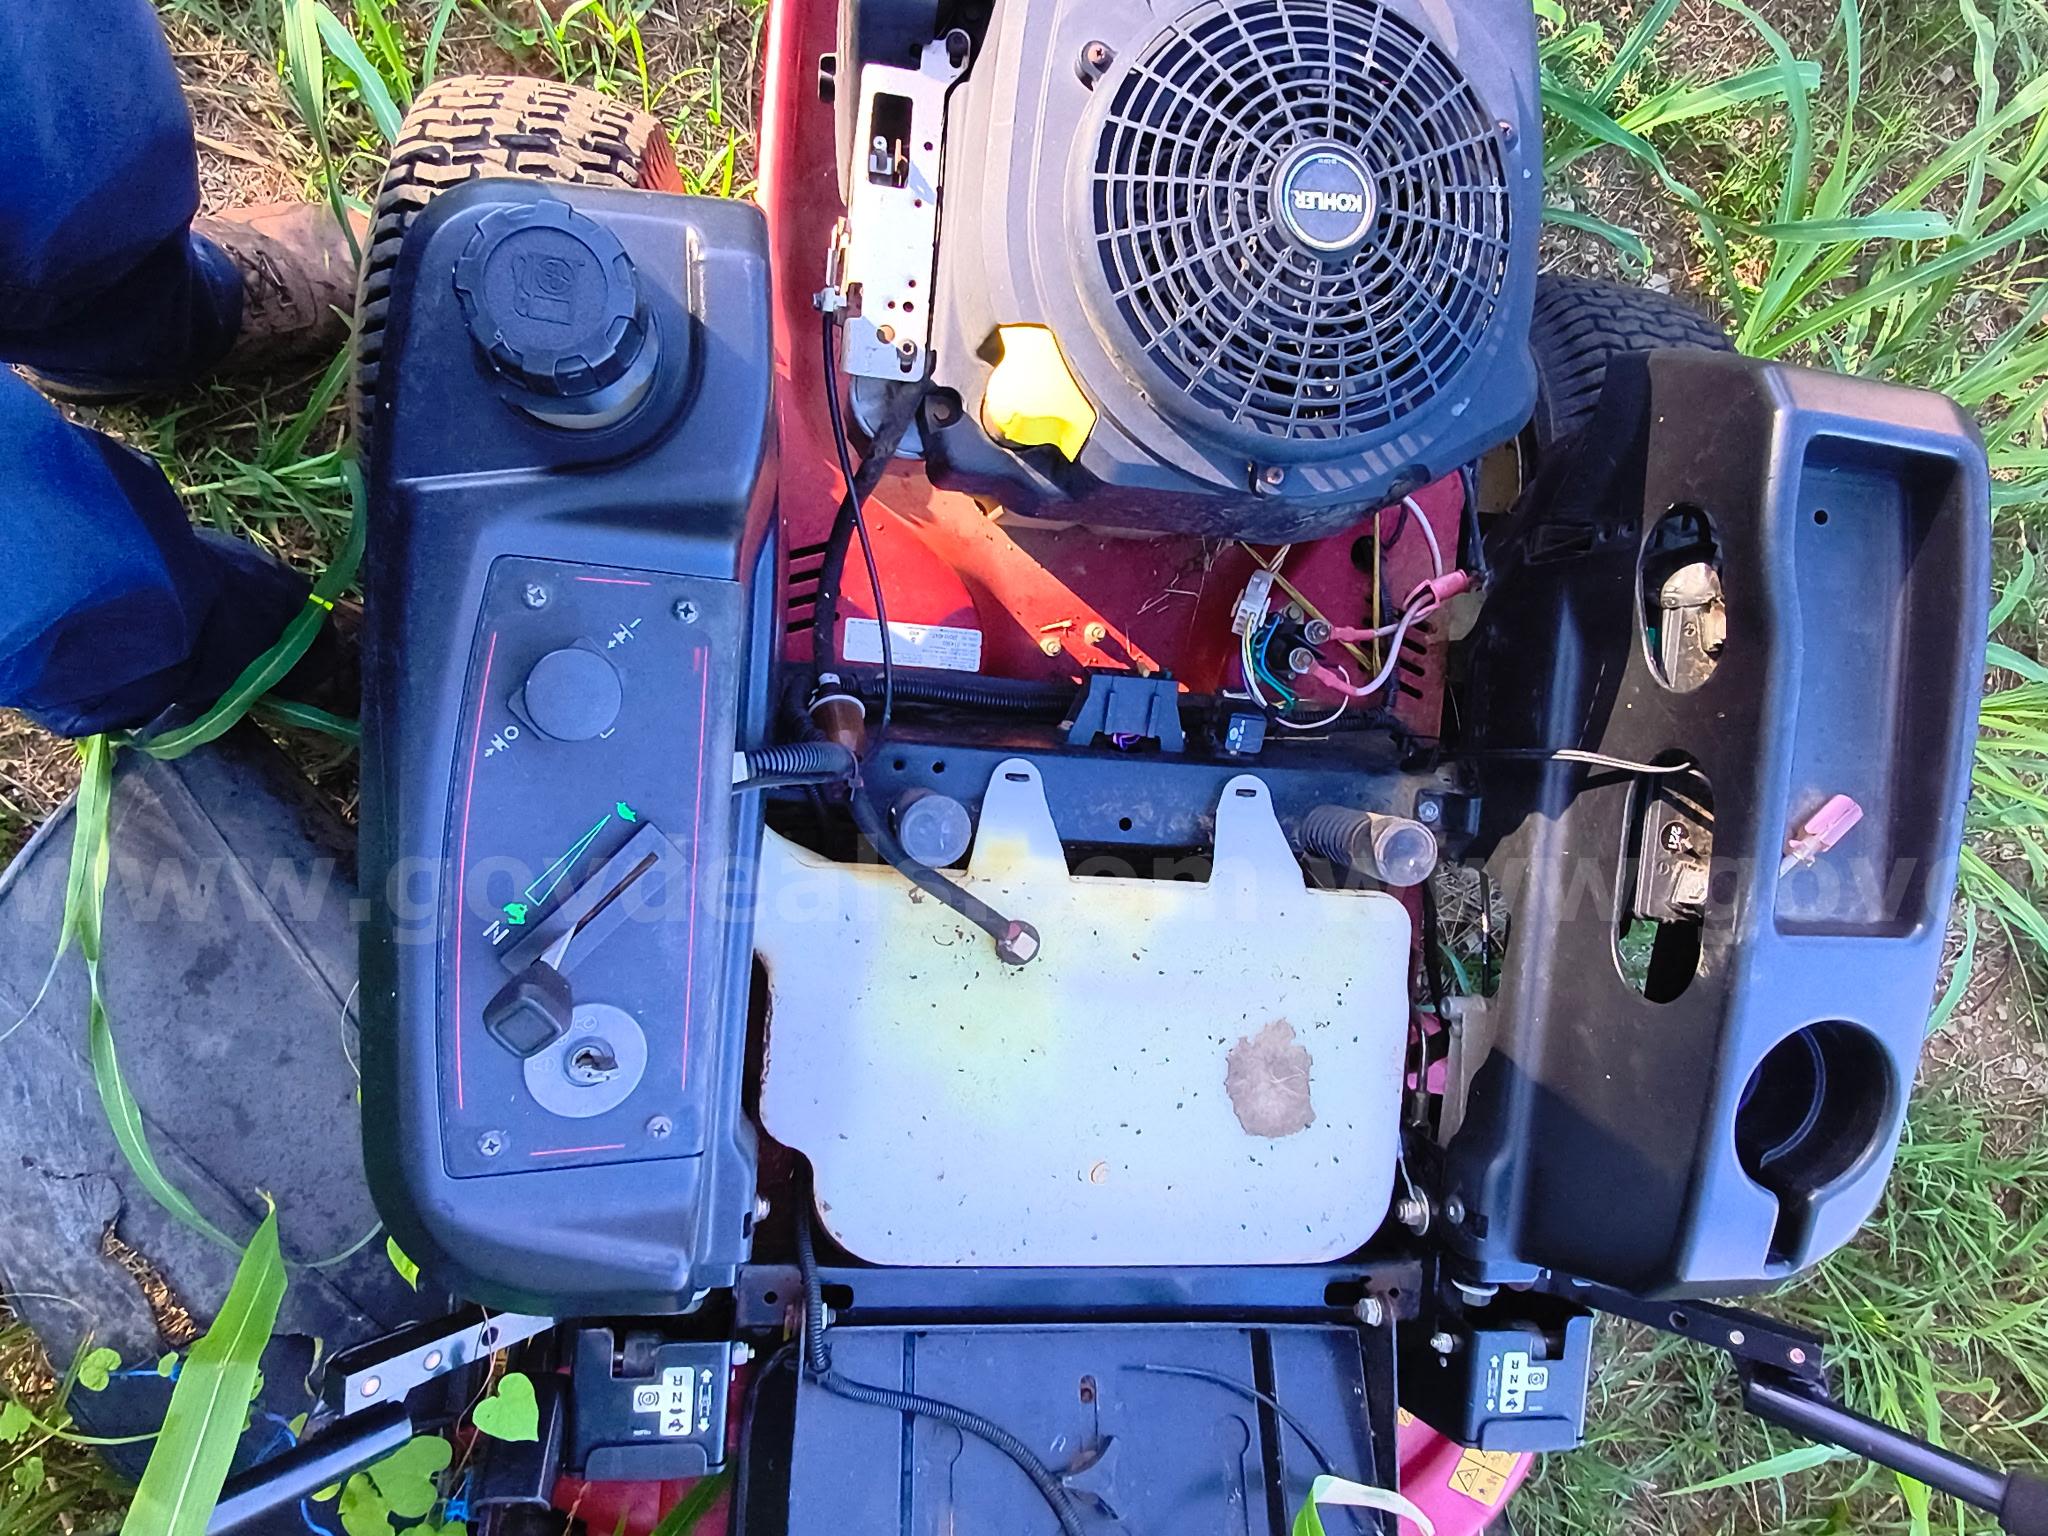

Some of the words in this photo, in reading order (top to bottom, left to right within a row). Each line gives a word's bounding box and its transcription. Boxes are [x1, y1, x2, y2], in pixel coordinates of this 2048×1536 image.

[1292, 189, 1363, 214] KOHLER
[673, 1375, 682, 1386] R
[1510, 1374, 1518, 1384] N
[672, 1392, 682, 1403] N
